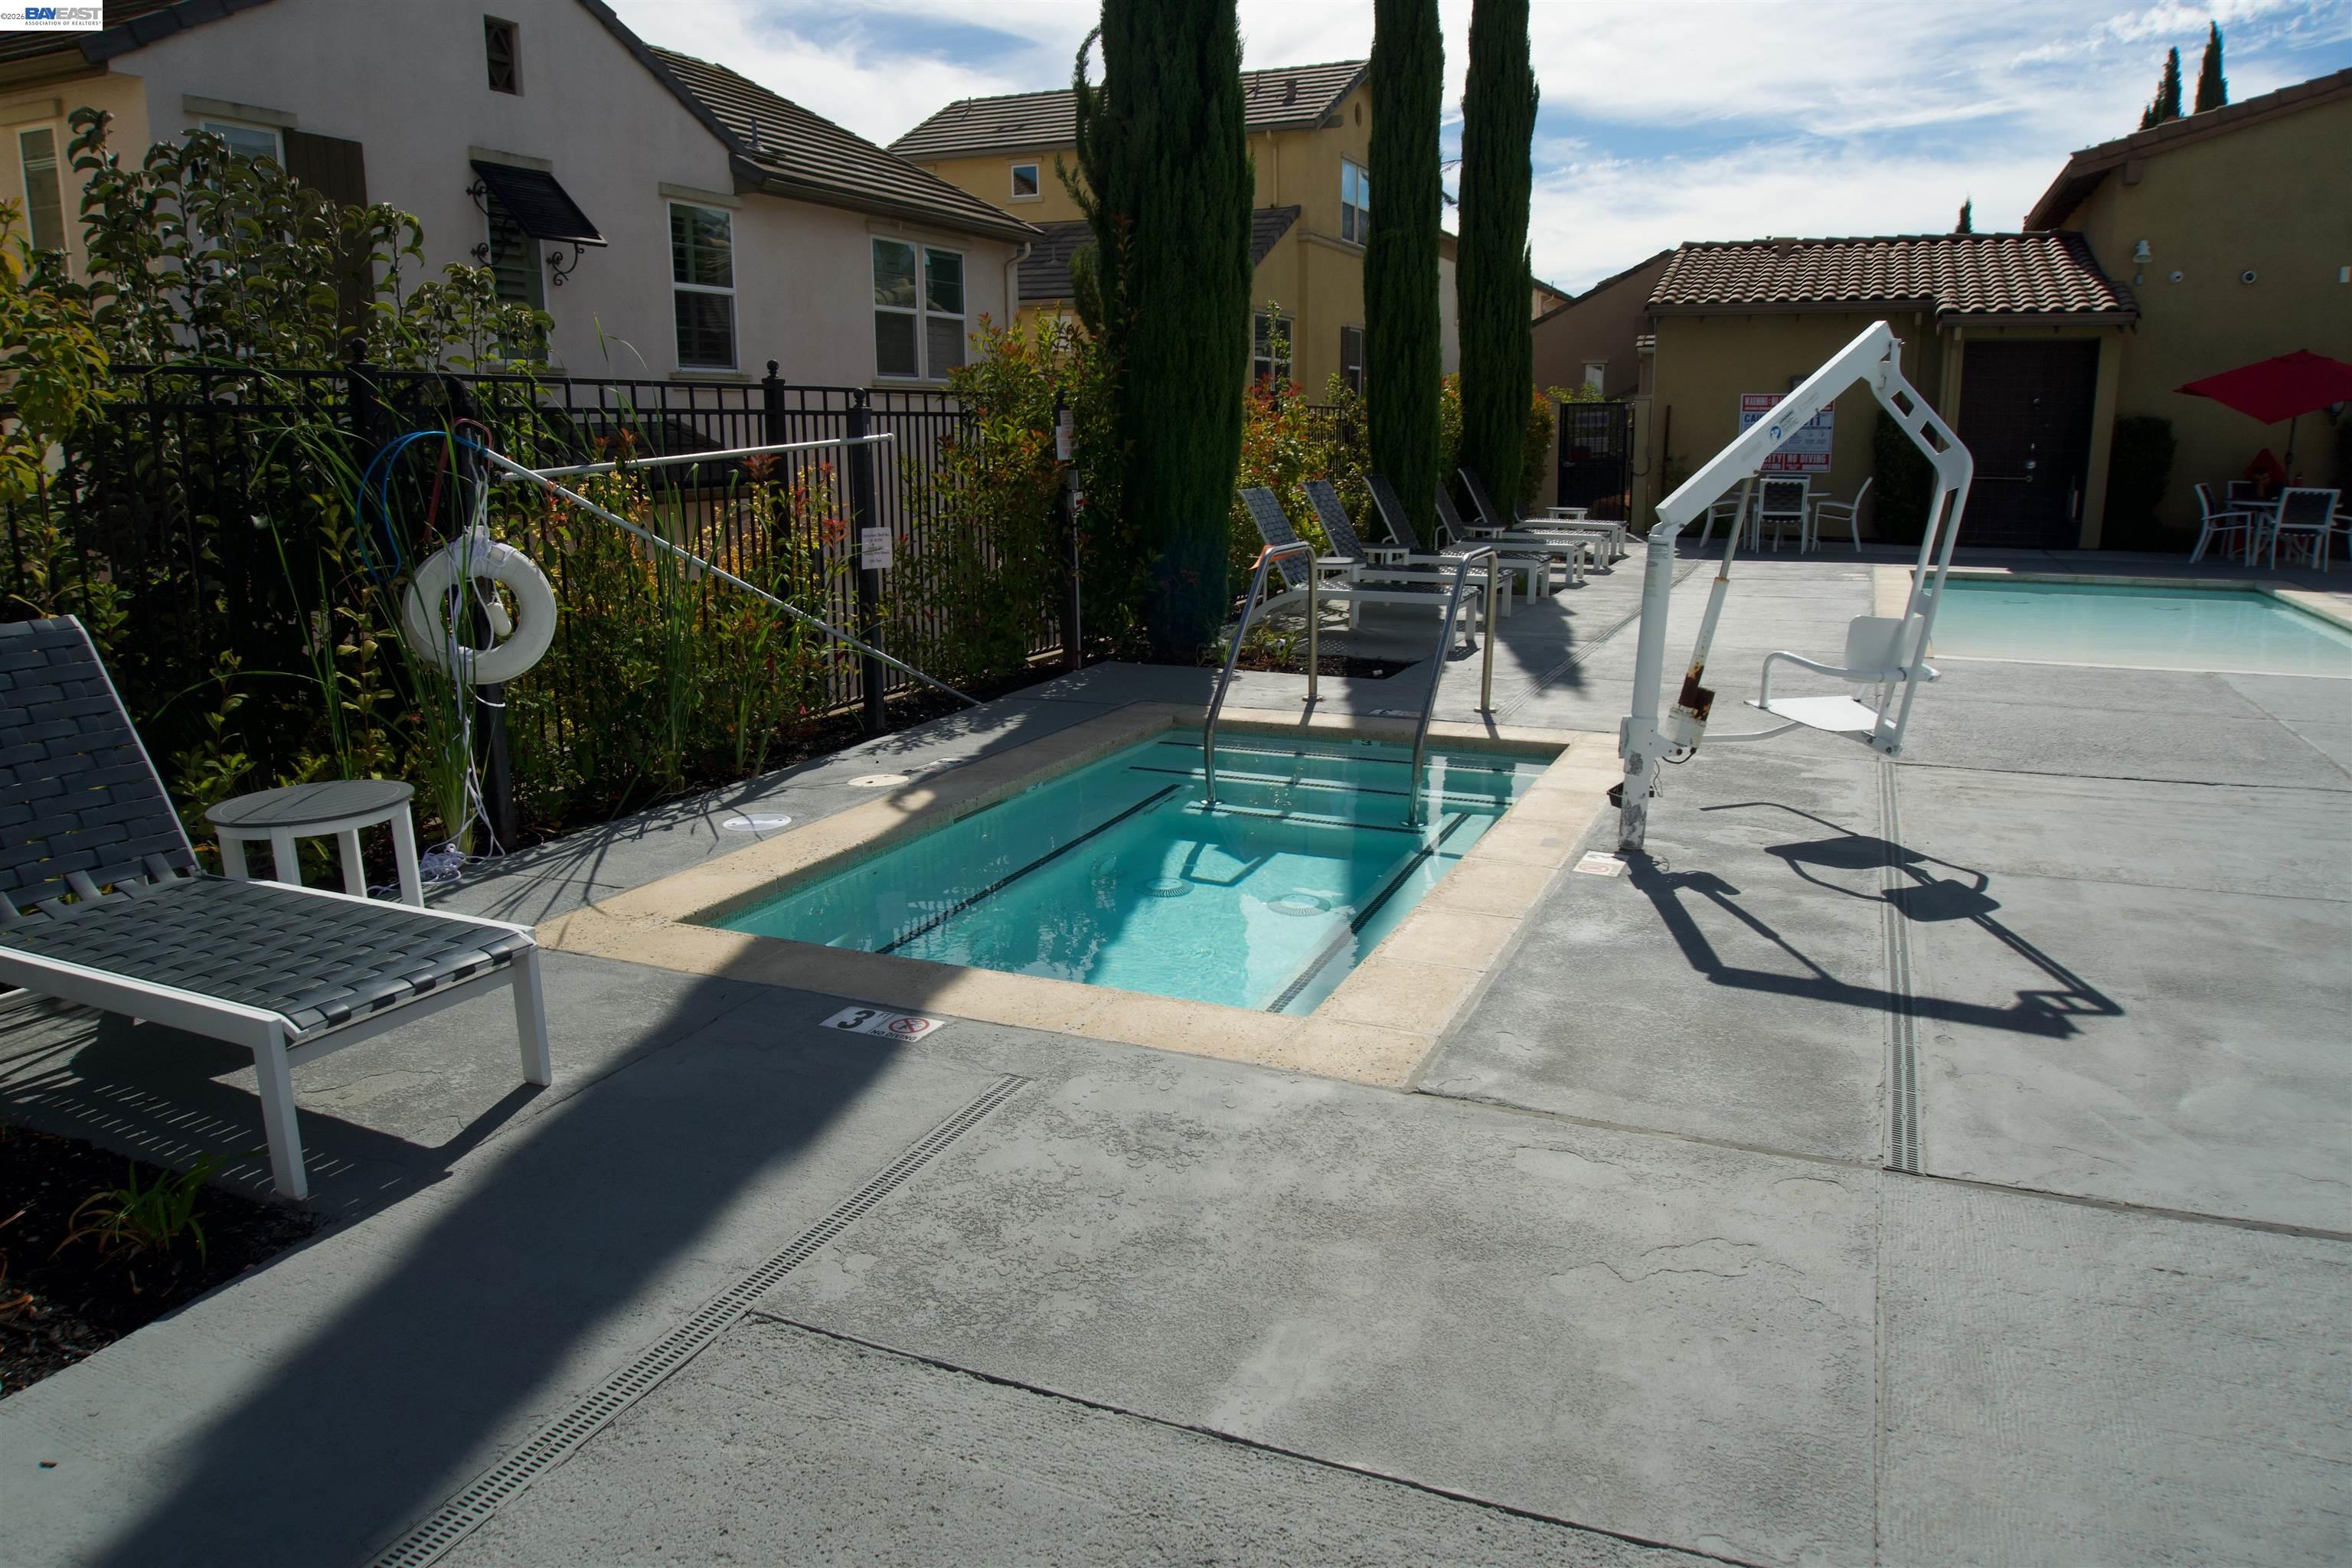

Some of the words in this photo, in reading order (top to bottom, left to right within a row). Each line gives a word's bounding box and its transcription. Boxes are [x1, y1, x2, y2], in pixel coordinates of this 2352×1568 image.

[1788, 454, 1798, 463] NO
[1800, 454, 1826, 464] DIVING
[837, 1010, 876, 1029] 3
[886, 1032, 917, 1040] DIVING
